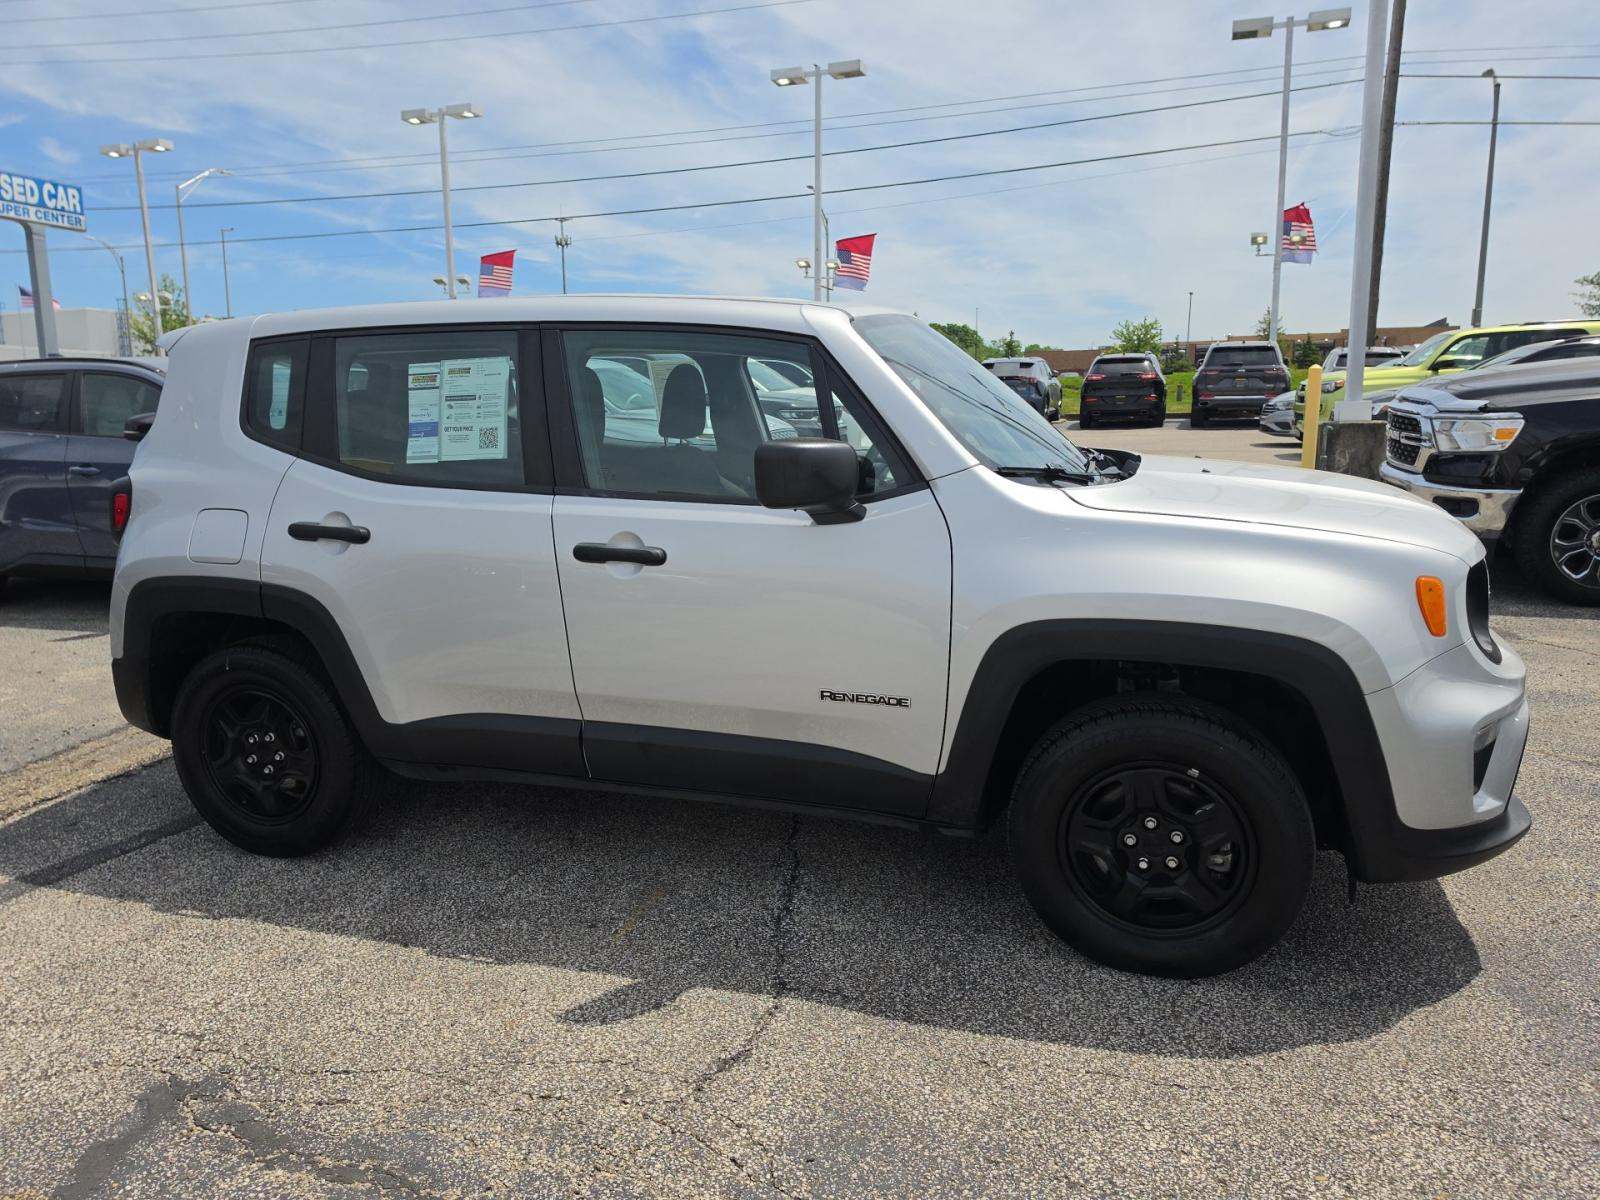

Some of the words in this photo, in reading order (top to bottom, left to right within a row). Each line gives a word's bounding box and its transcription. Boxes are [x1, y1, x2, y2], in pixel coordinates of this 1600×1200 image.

[42, 182, 81, 213] CAR
[35, 209, 82, 226] CENTER
[820, 690, 910, 708] RENEGADE
